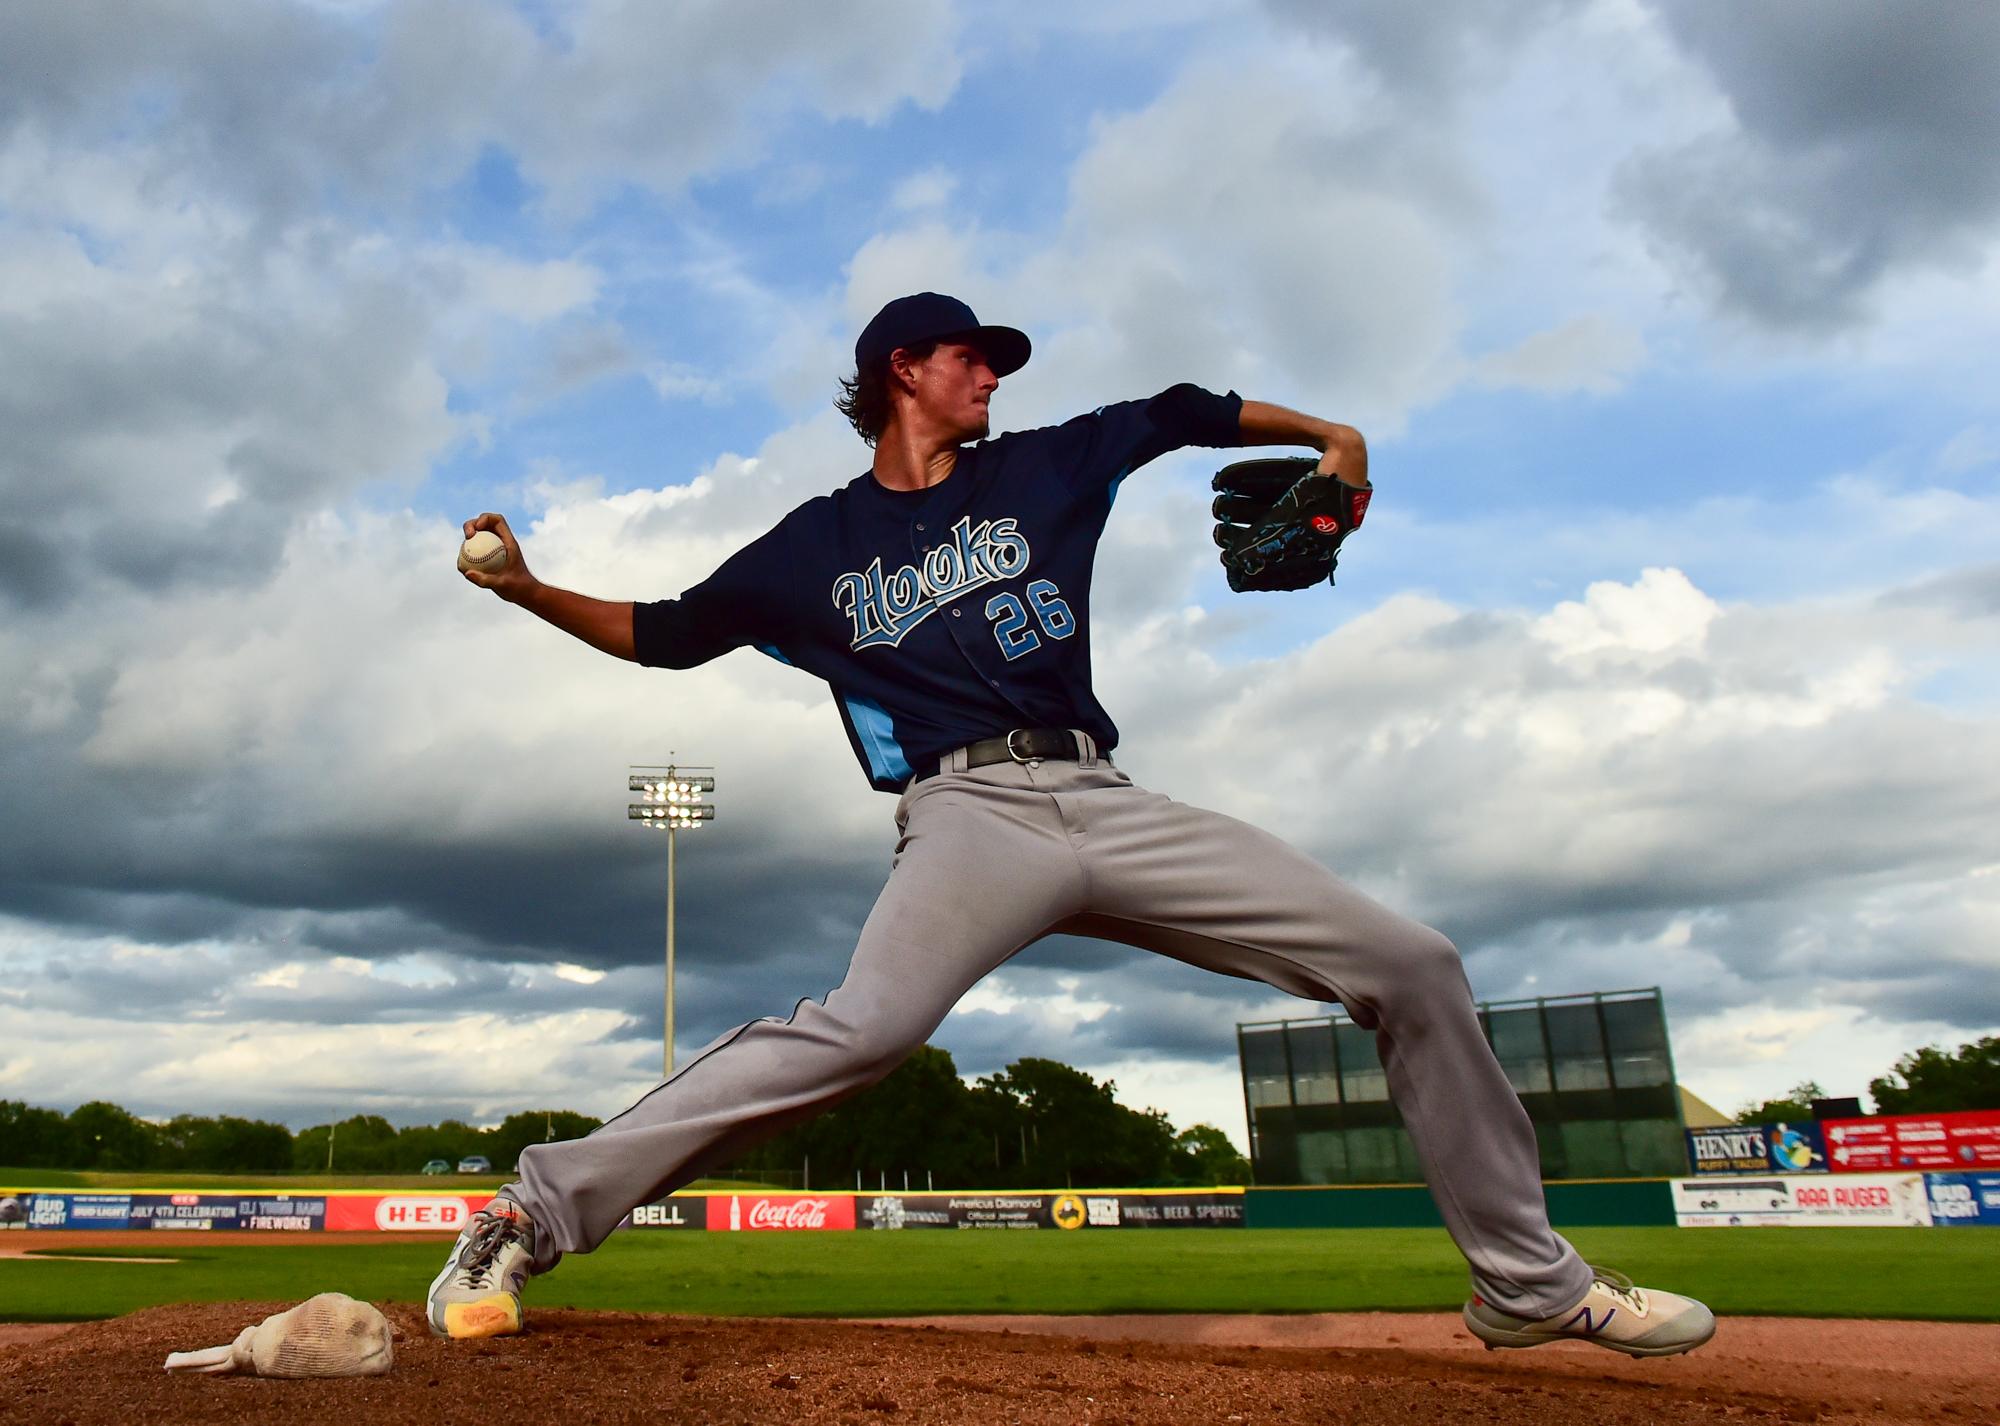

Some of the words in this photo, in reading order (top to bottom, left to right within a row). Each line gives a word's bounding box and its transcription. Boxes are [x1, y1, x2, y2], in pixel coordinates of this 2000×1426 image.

[832, 515, 1030, 652] Hooks
[985, 579, 1076, 661] 26
[1692, 1133, 1767, 1159] HENRY'S
[948, 1198, 994, 1209] Americus
[995, 1197, 1042, 1209] Diamond
[1796, 1188, 1829, 1207] AAA
[1834, 1186, 1892, 1207] AUGER
[34, 1199, 65, 1212] BUD
[96, 1207, 127, 1217] LIGHT
[130, 1206, 154, 1217] JULY
[176, 1206, 237, 1218] CELEBRATION
[29, 1212, 66, 1224] LIGHT
[632, 1206, 685, 1225] BELL
[250, 1216, 311, 1230] FIREWORKS
